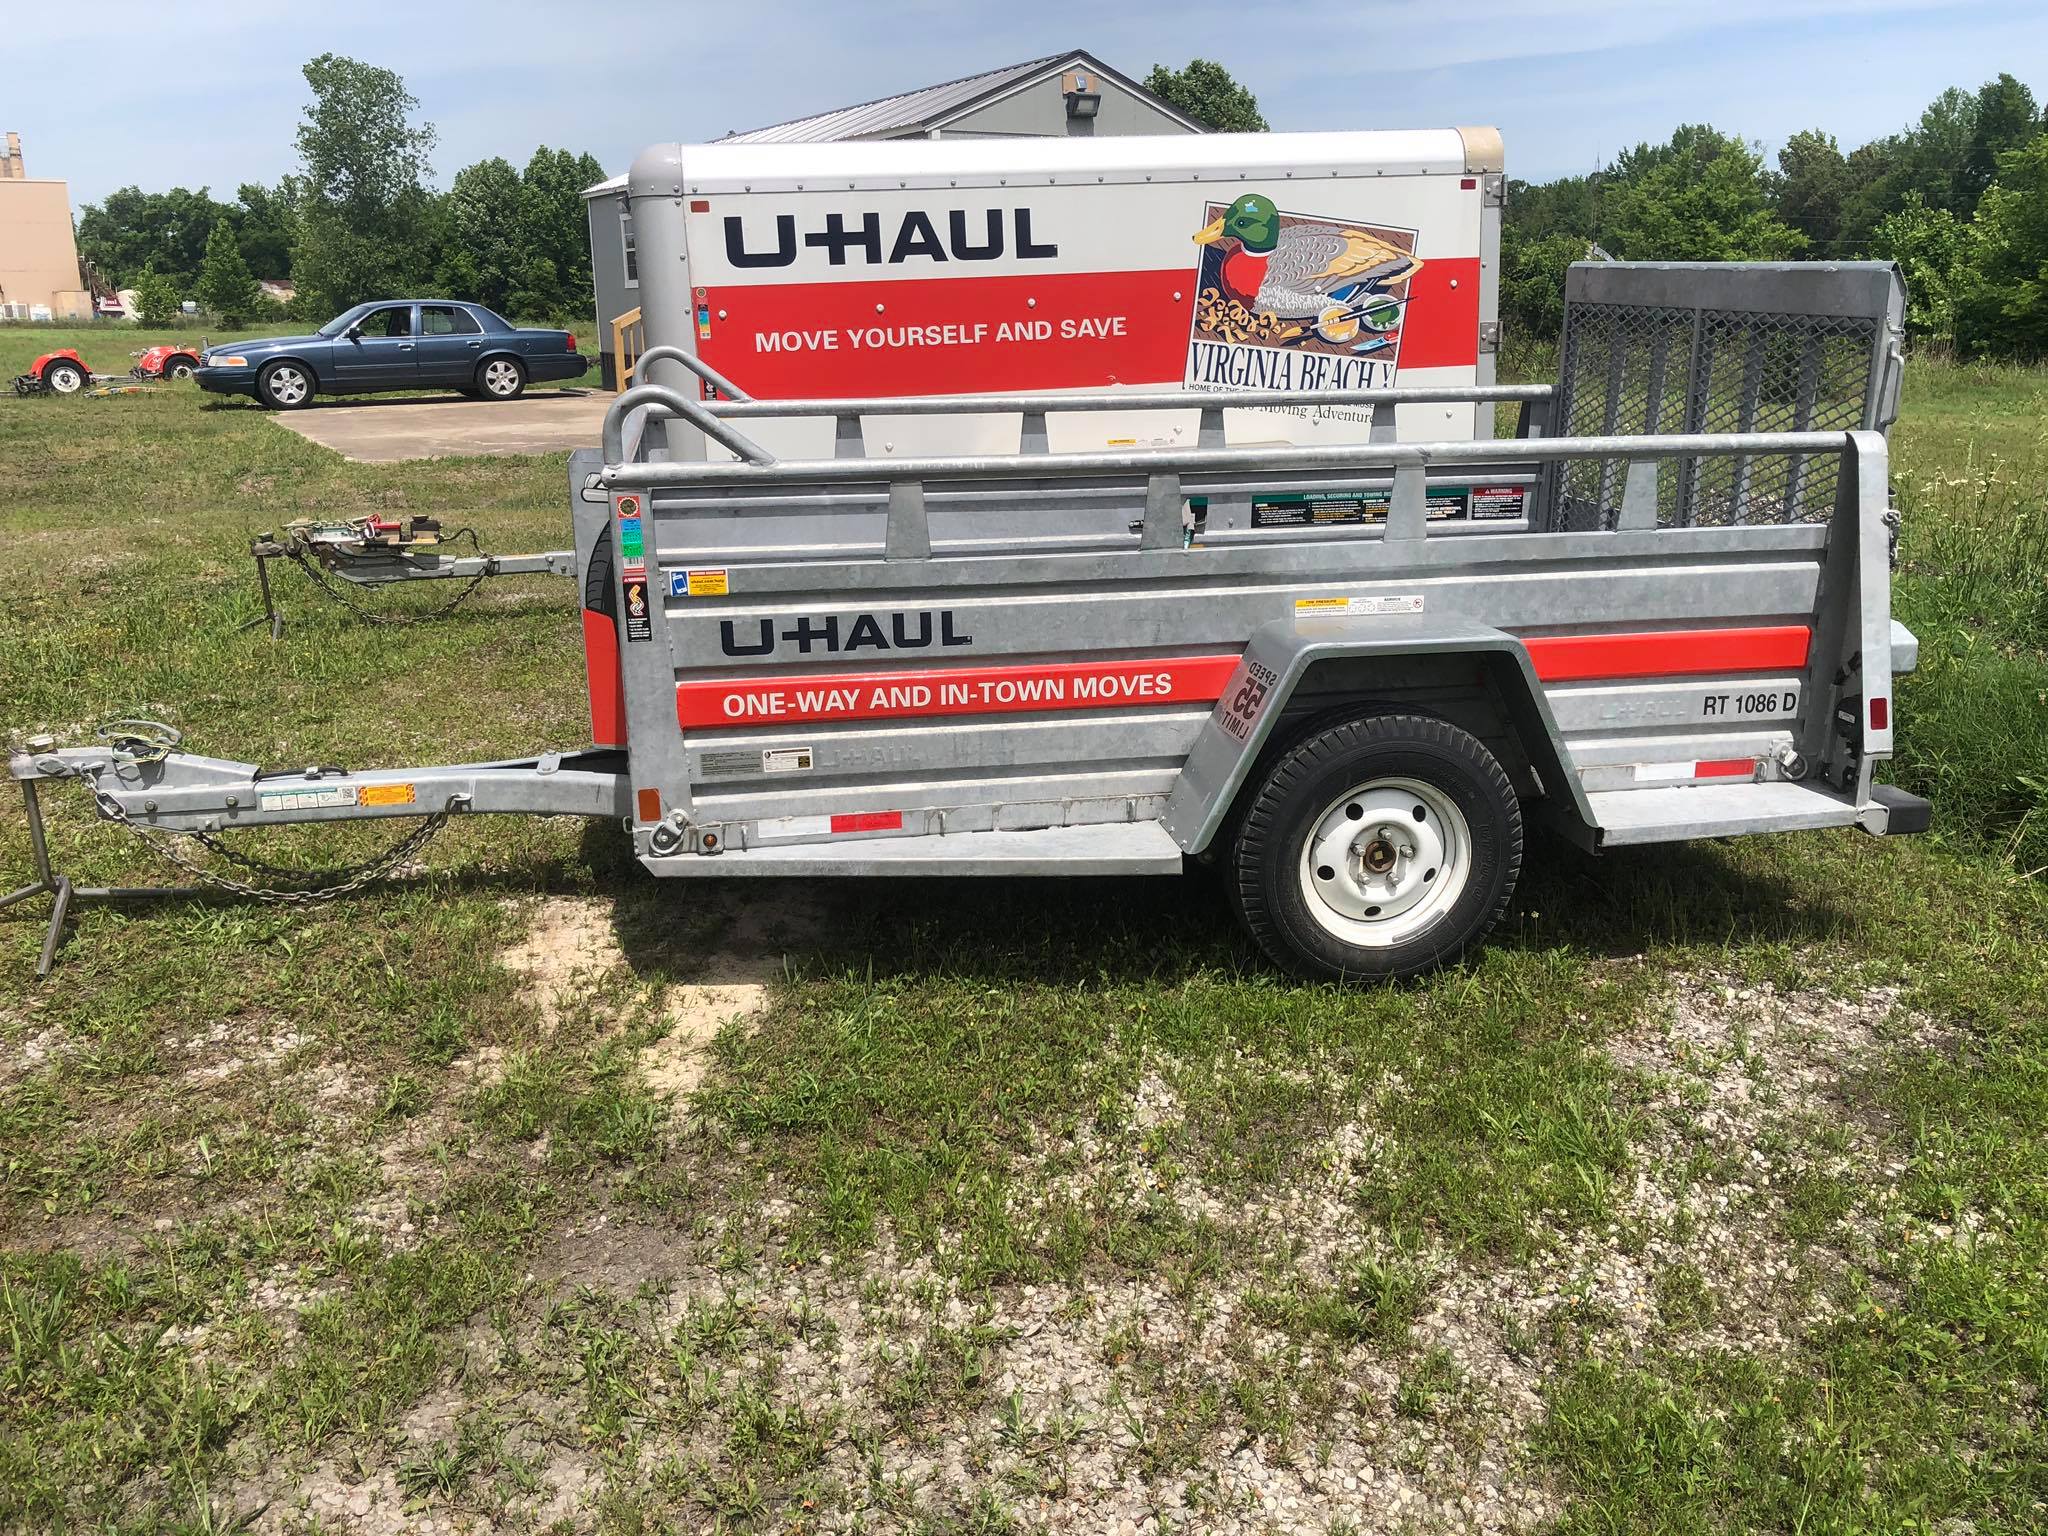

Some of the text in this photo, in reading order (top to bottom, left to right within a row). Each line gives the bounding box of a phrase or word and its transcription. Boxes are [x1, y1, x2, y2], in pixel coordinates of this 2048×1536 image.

[724, 208, 1058, 269] U-HAUL
[755, 316, 1127, 353] MOVE YOURSELF AND SAVE
[1188, 384, 1211, 392] HOME
[1191, 342, 1292, 391] VIRGINIA
[1300, 354, 1376, 390] BEACH
[720, 610, 972, 657] U-HAUL
[723, 673, 1173, 717] ONE-WAY AND IN-TOWN MOVES
[1703, 692, 1797, 716] RT 1086 D
